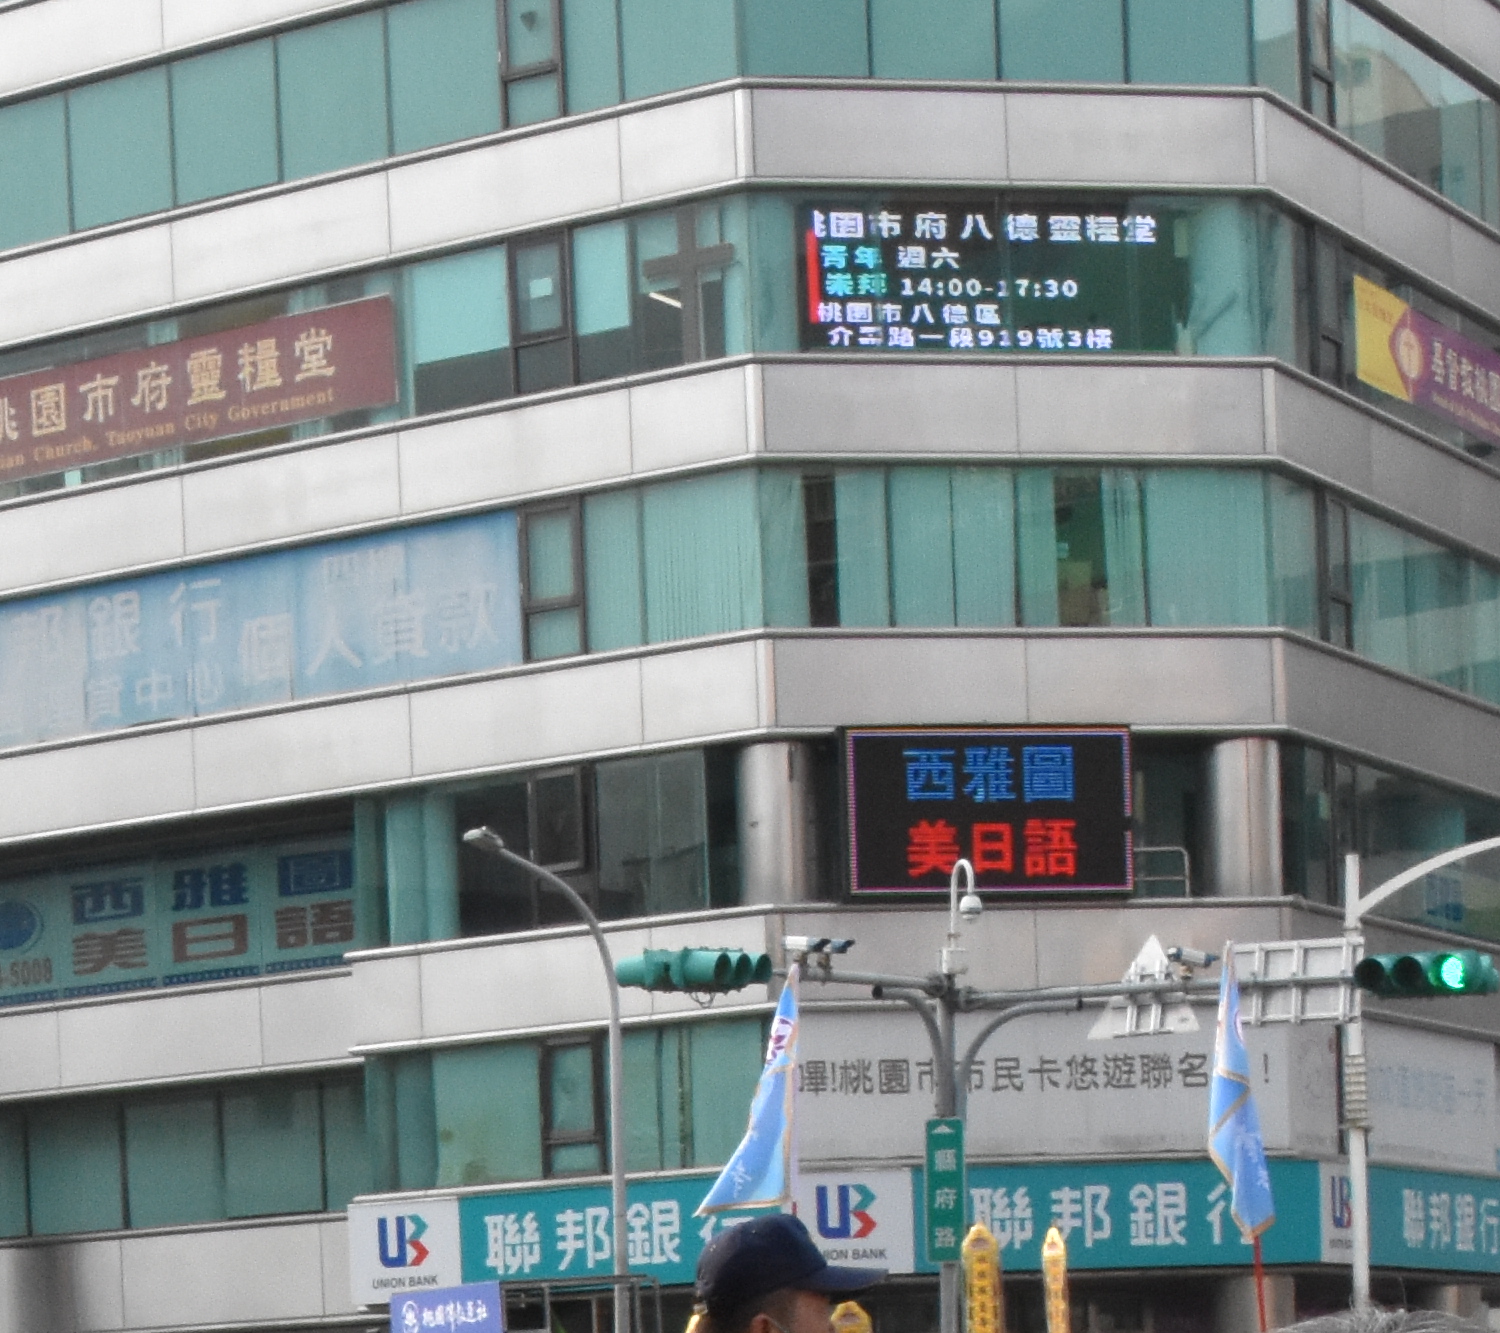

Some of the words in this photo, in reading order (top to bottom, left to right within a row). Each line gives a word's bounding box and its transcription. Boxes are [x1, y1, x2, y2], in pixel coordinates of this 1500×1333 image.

[821, 245, 884, 270] 青年
[896, 245, 961, 270] 週六
[899, 277, 1079, 298] 14:00-17:30
[107, 420, 176, 449] Taoyuan
[184, 411, 220, 433] City
[227, 388, 336, 423] Government
[902, 744, 1076, 804] 西雅圖
[906, 818, 1079, 879] 美日語
[71, 848, 355, 926] 西雅圖
[72, 898, 355, 976] 美日語
[1401, 1187, 1500, 1256] 聯邦銀行
[372, 1274, 406, 1290] UNION
[408, 1273, 440, 1288] BANK
[851, 1247, 888, 1261] BANK
